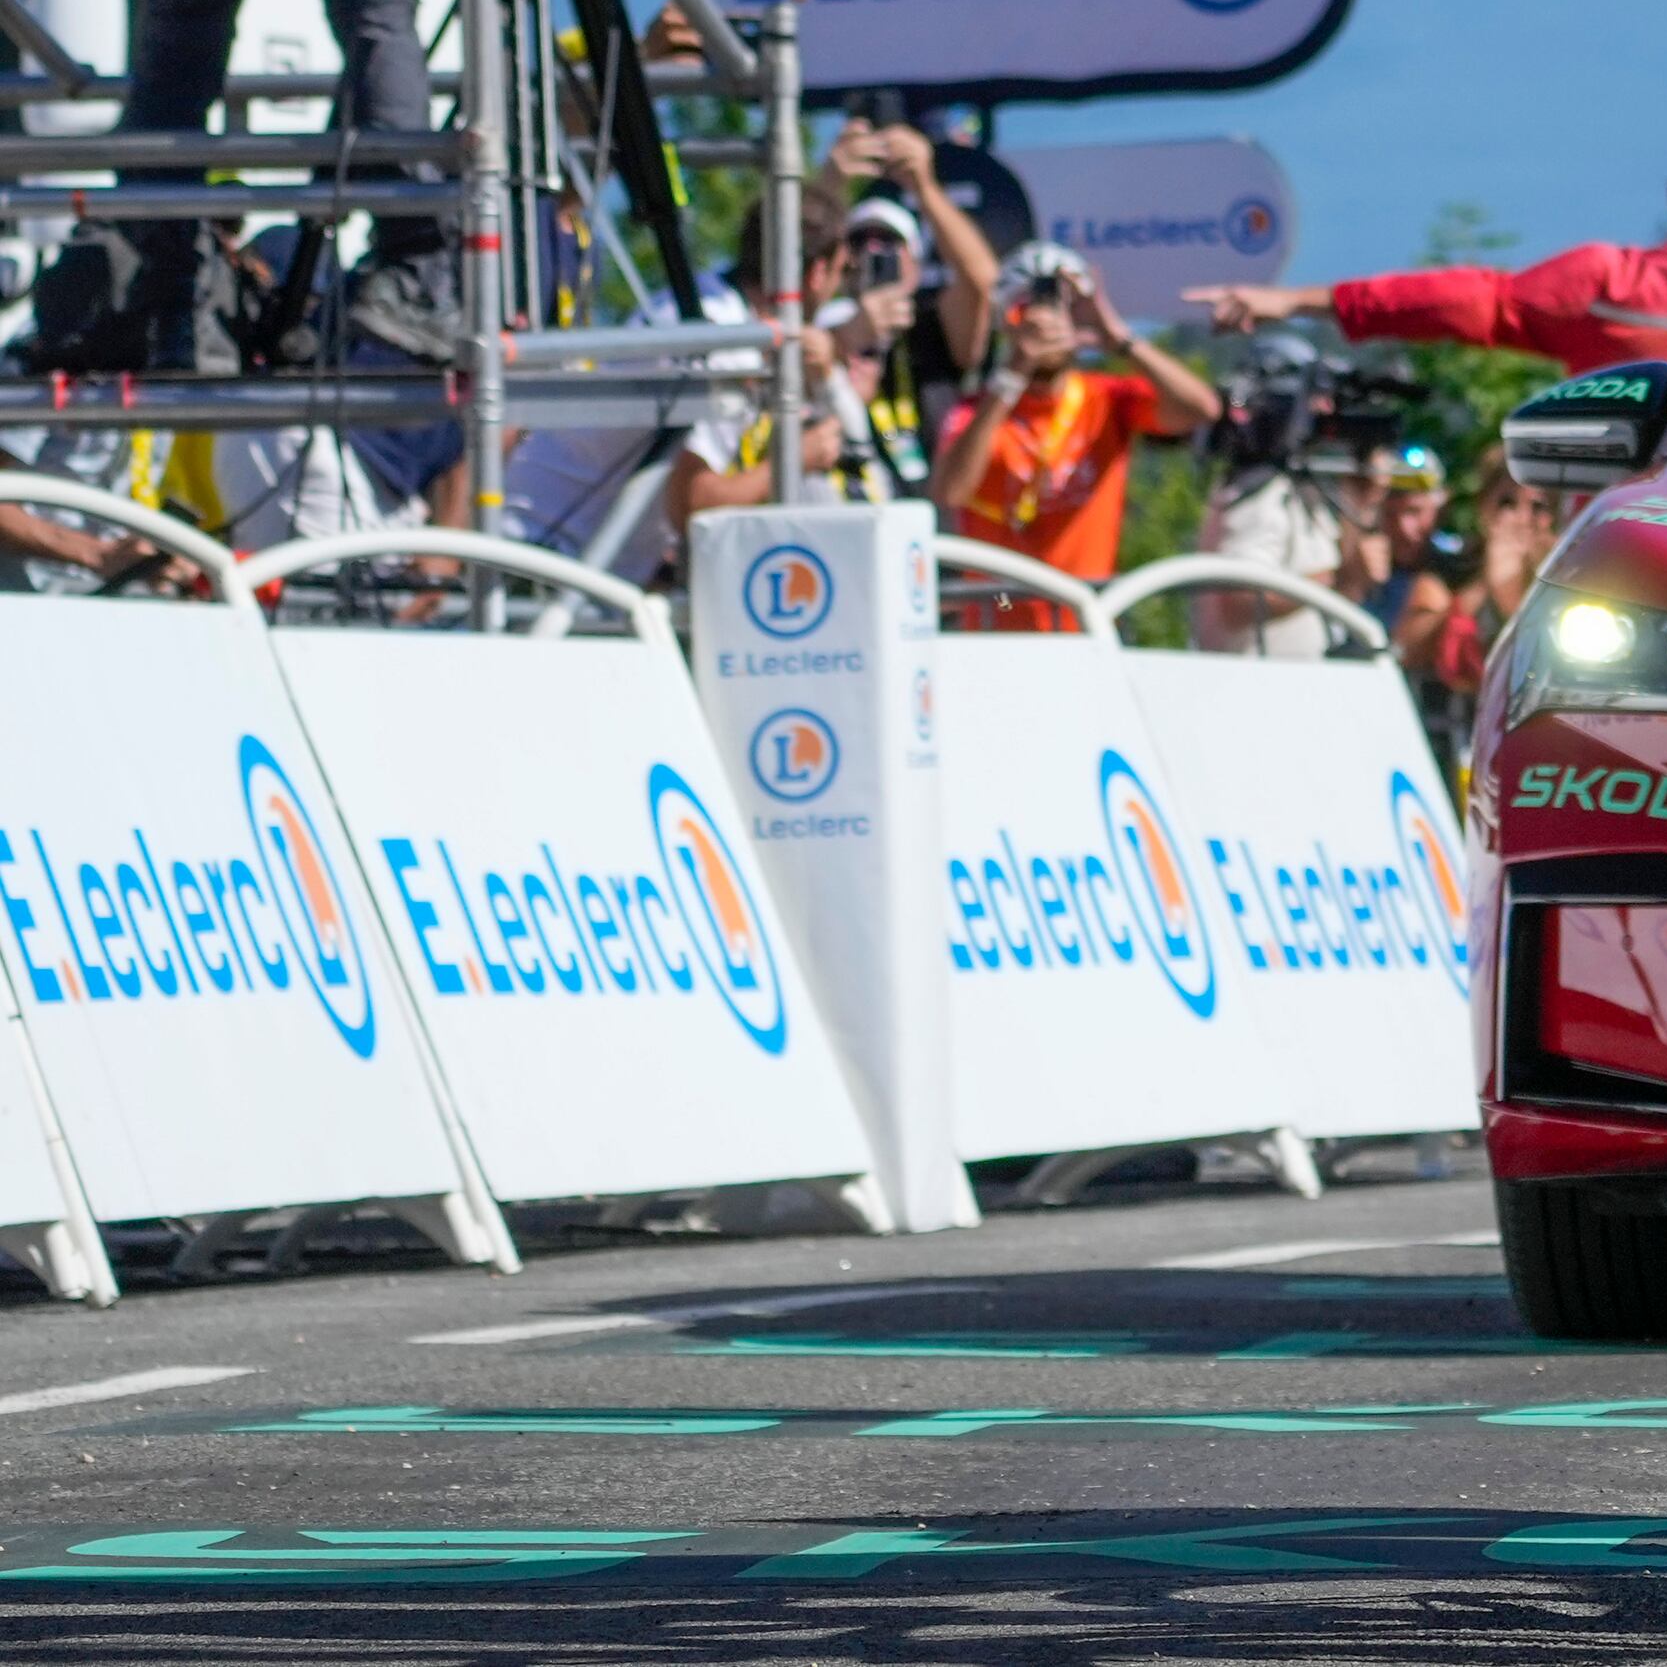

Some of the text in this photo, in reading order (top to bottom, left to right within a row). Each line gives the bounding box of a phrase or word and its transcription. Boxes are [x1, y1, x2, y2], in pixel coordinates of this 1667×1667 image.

[718, 651, 864, 679] E.Leclerc
[753, 813, 871, 841] Leclerc
[379, 838, 695, 994] E.Leclerc
[1207, 838, 1428, 972] E.Leclerc
